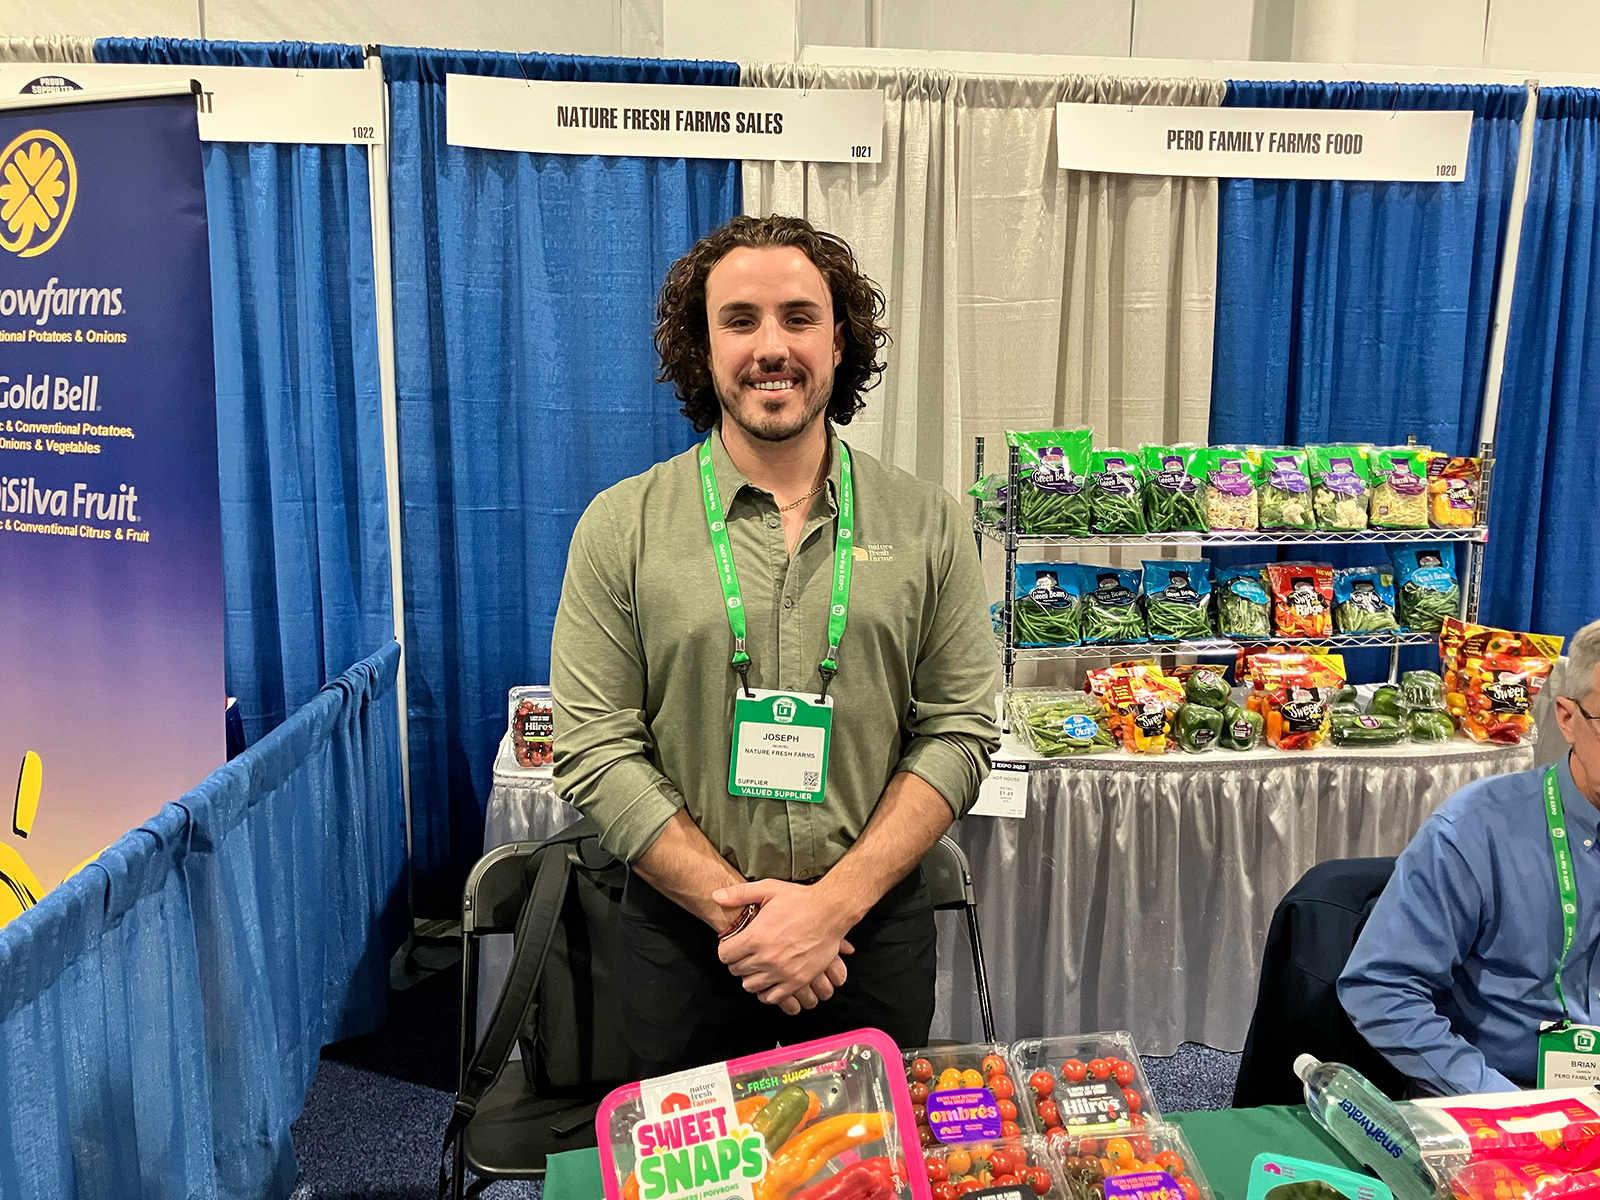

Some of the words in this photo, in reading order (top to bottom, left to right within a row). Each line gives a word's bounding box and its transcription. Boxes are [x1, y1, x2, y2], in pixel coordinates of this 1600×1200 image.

[40, 77, 65, 86] PROUD
[197, 92, 214, 113] IT
[557, 105, 618, 129] NATURE
[623, 108, 671, 131] FRESH
[675, 110, 731, 133] FARMS
[735, 112, 784, 134] SALES
[352, 127, 375, 138] 1022
[1167, 129, 1204, 151] PERO
[1208, 130, 1265, 152] FAMILY
[1268, 132, 1321, 154] FARMS
[1325, 133, 1363, 155] FOOD
[851, 145, 872, 158] 1021
[1435, 164, 1458, 177] 1020
[0, 277, 122, 326] owfarms
[28, 330, 73, 342] Potatoes
[74, 330, 83, 342] &
[86, 330, 128, 343] Onions
[0, 374, 50, 410] Gold
[53, 375, 99, 411] Bell
[5, 419, 14, 432] &
[15, 420, 81, 435] Conventional
[82, 422, 135, 440] Potatoes,
[0, 437, 32, 451] Onions
[34, 438, 43, 451] &
[45, 439, 101, 455] Vegetables
[1034, 472, 1054, 482] Green
[0, 476, 68, 516] iSilva
[73, 483, 138, 522] Fruit
[13, 519, 78, 536] Conventional
[79, 525, 111, 540] Citrus
[114, 527, 124, 540] &
[126, 528, 150, 543] Fruit
[1032, 591, 1049, 600] Green
[1050, 591, 1067, 600] Beans
[1111, 591, 1128, 599] Beans
[1296, 604, 1325, 616] Rings
[1494, 683, 1525, 699] Sweet
[763, 733, 800, 743] JOSEPH
[1075, 727, 1090, 736] Okra
[745, 748, 770, 756] NATURE
[794, 751, 815, 759] FARMS
[738, 778, 769, 786] SUPPLIER
[741, 787, 773, 797] VALUED
[774, 791, 812, 800] SUPPLIER
[747, 1076, 779, 1093] FRESH
[781, 1067, 812, 1085] JUICY
[689, 1082, 716, 1093] nature
[691, 1089, 713, 1100] fresh
[692, 1096, 717, 1108] farms
[1062, 1098, 1120, 1115] Hiiros
[637, 1106, 728, 1157] SWEET
[1338, 1098, 1404, 1159] smartwater
[640, 1137, 763, 1200] SNAPS
[703, 1183, 740, 1198] POIVRONS
